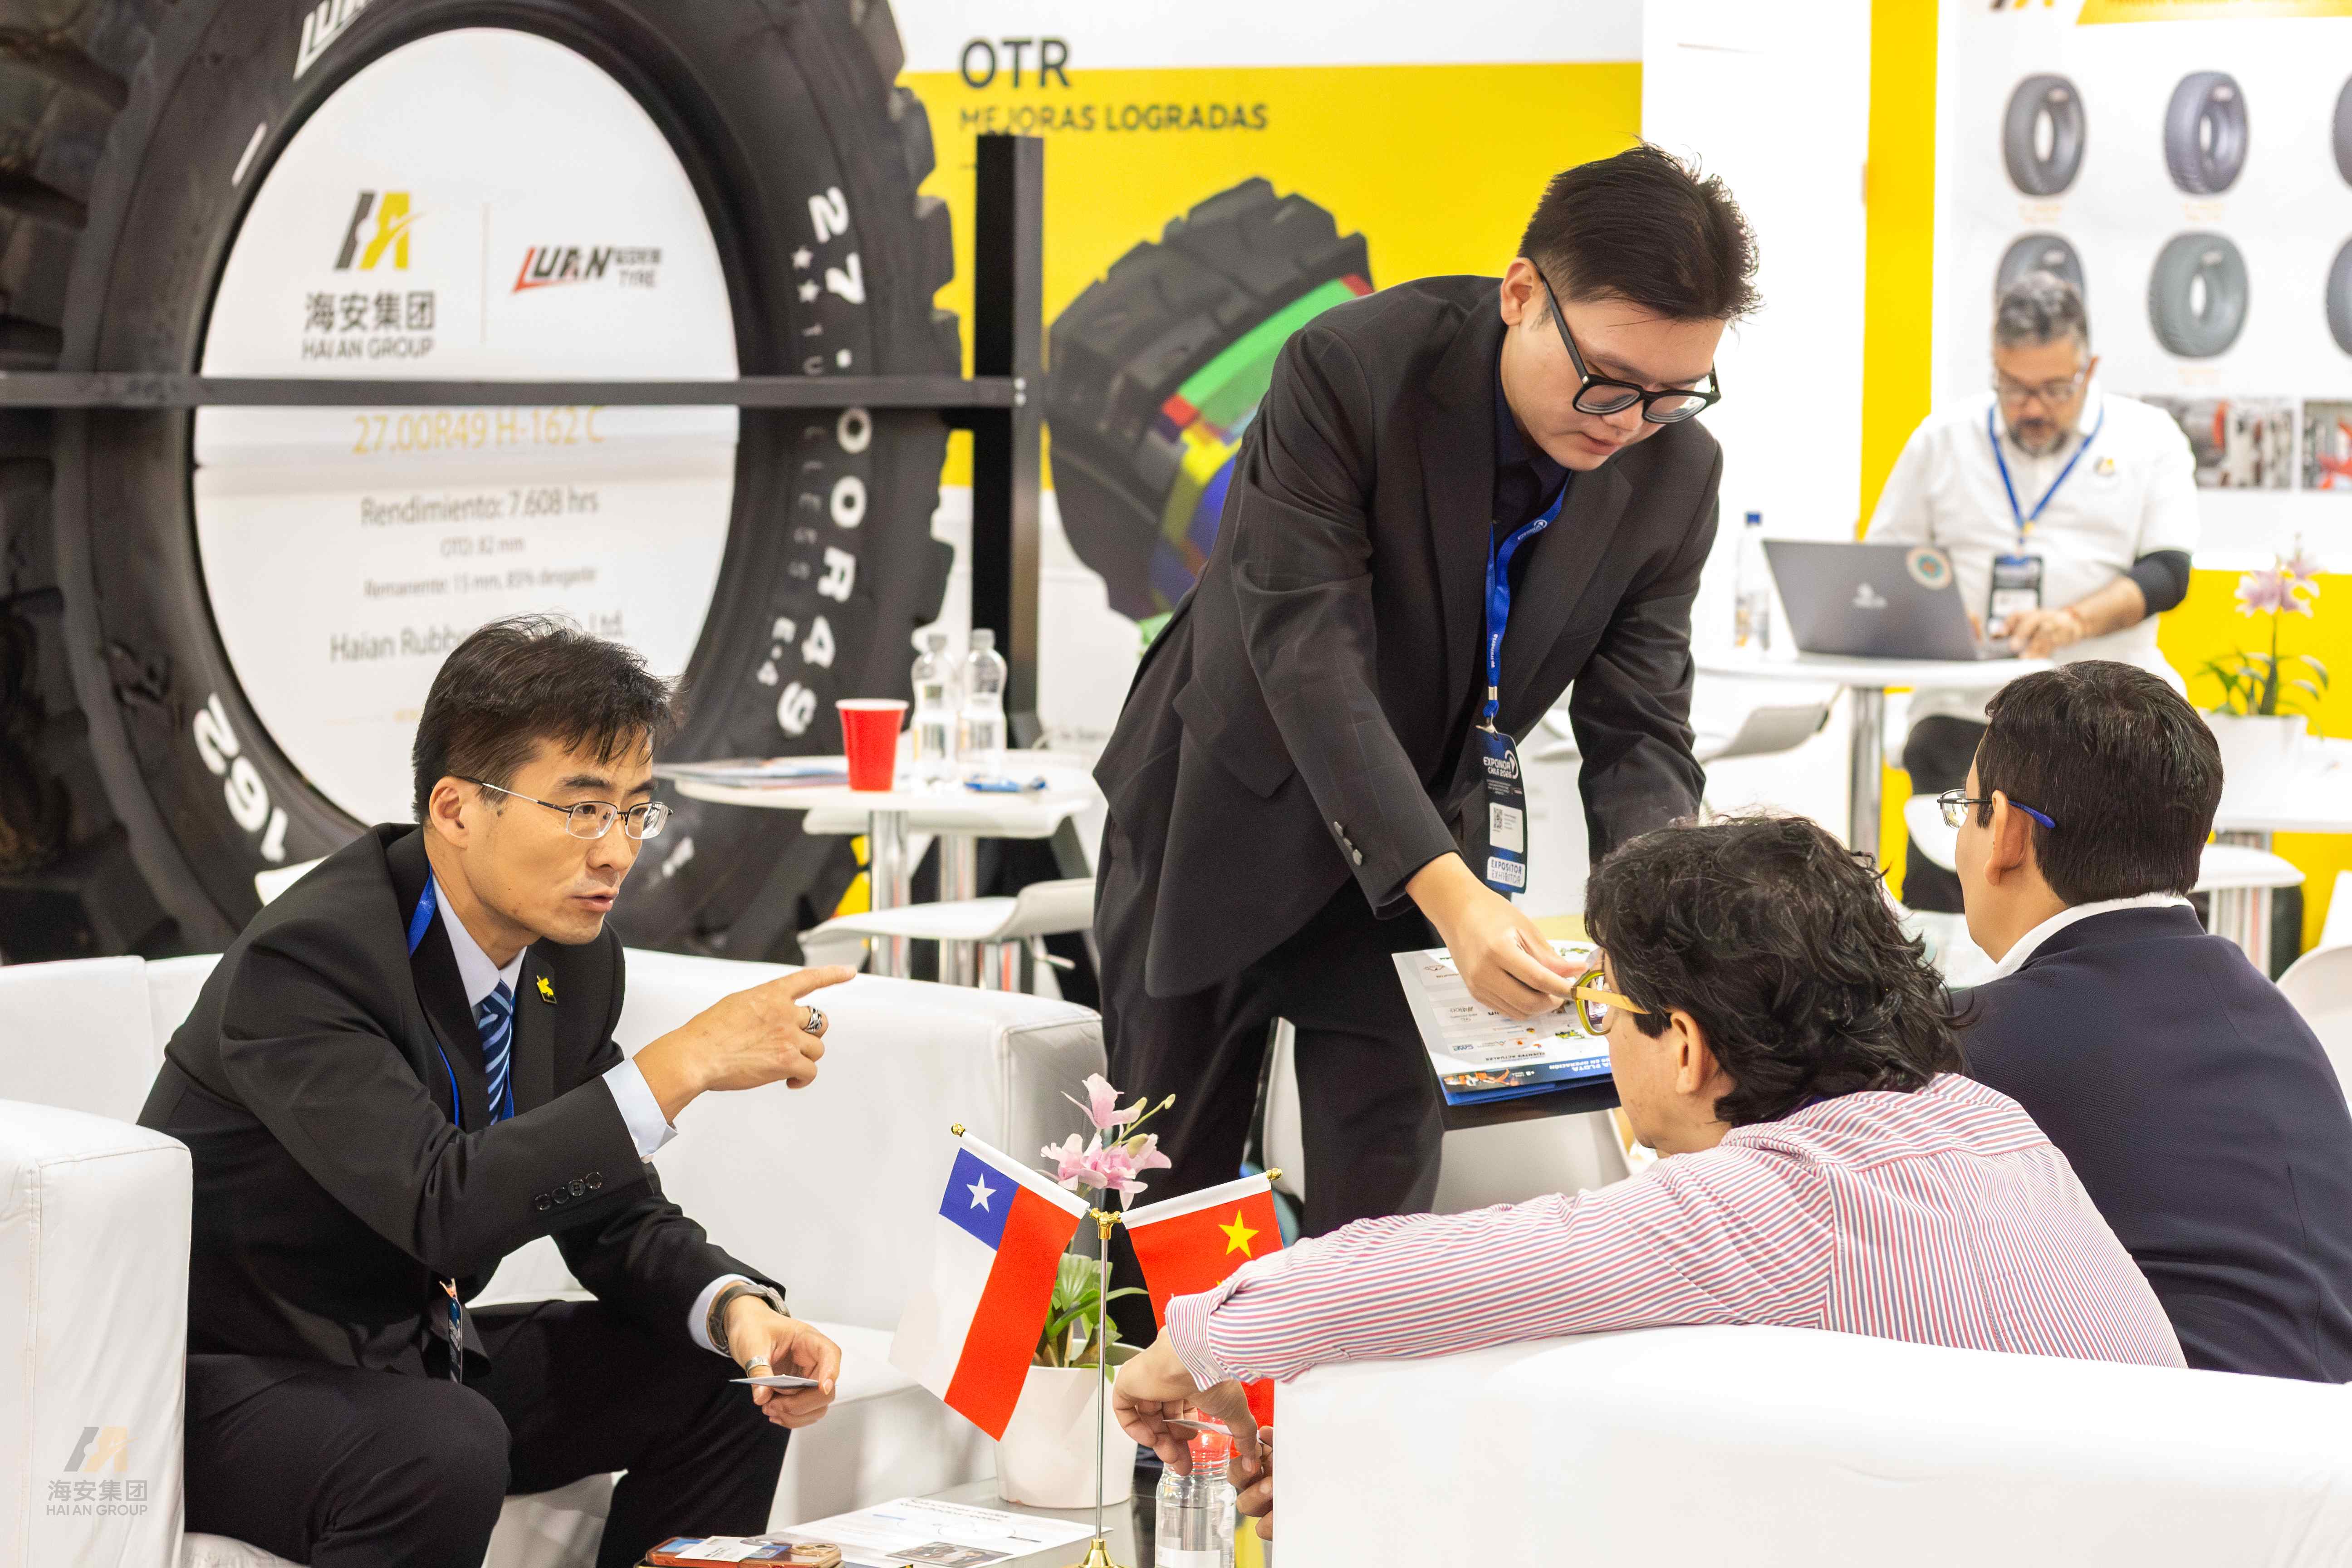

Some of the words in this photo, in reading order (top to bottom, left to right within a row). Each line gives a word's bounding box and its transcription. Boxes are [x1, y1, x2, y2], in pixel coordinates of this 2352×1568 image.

[960, 38, 1071, 89] OTR
[959, 105, 1096, 134] MEJORAS
[1105, 103, 1269, 132] LOGRADAS
[304, 289, 436, 333] 海安集团
[367, 336, 436, 360] GROUP
[352, 409, 488, 454] 27.00R49
[495, 406, 579, 445] H-162
[360, 493, 503, 527] Rendimiento:
[568, 485, 599, 513] hrs
[329, 630, 396, 663] Haian
[1491, 859, 1522, 875] EXPOSITOR
[1491, 870, 1521, 884] EXHIBITOR
